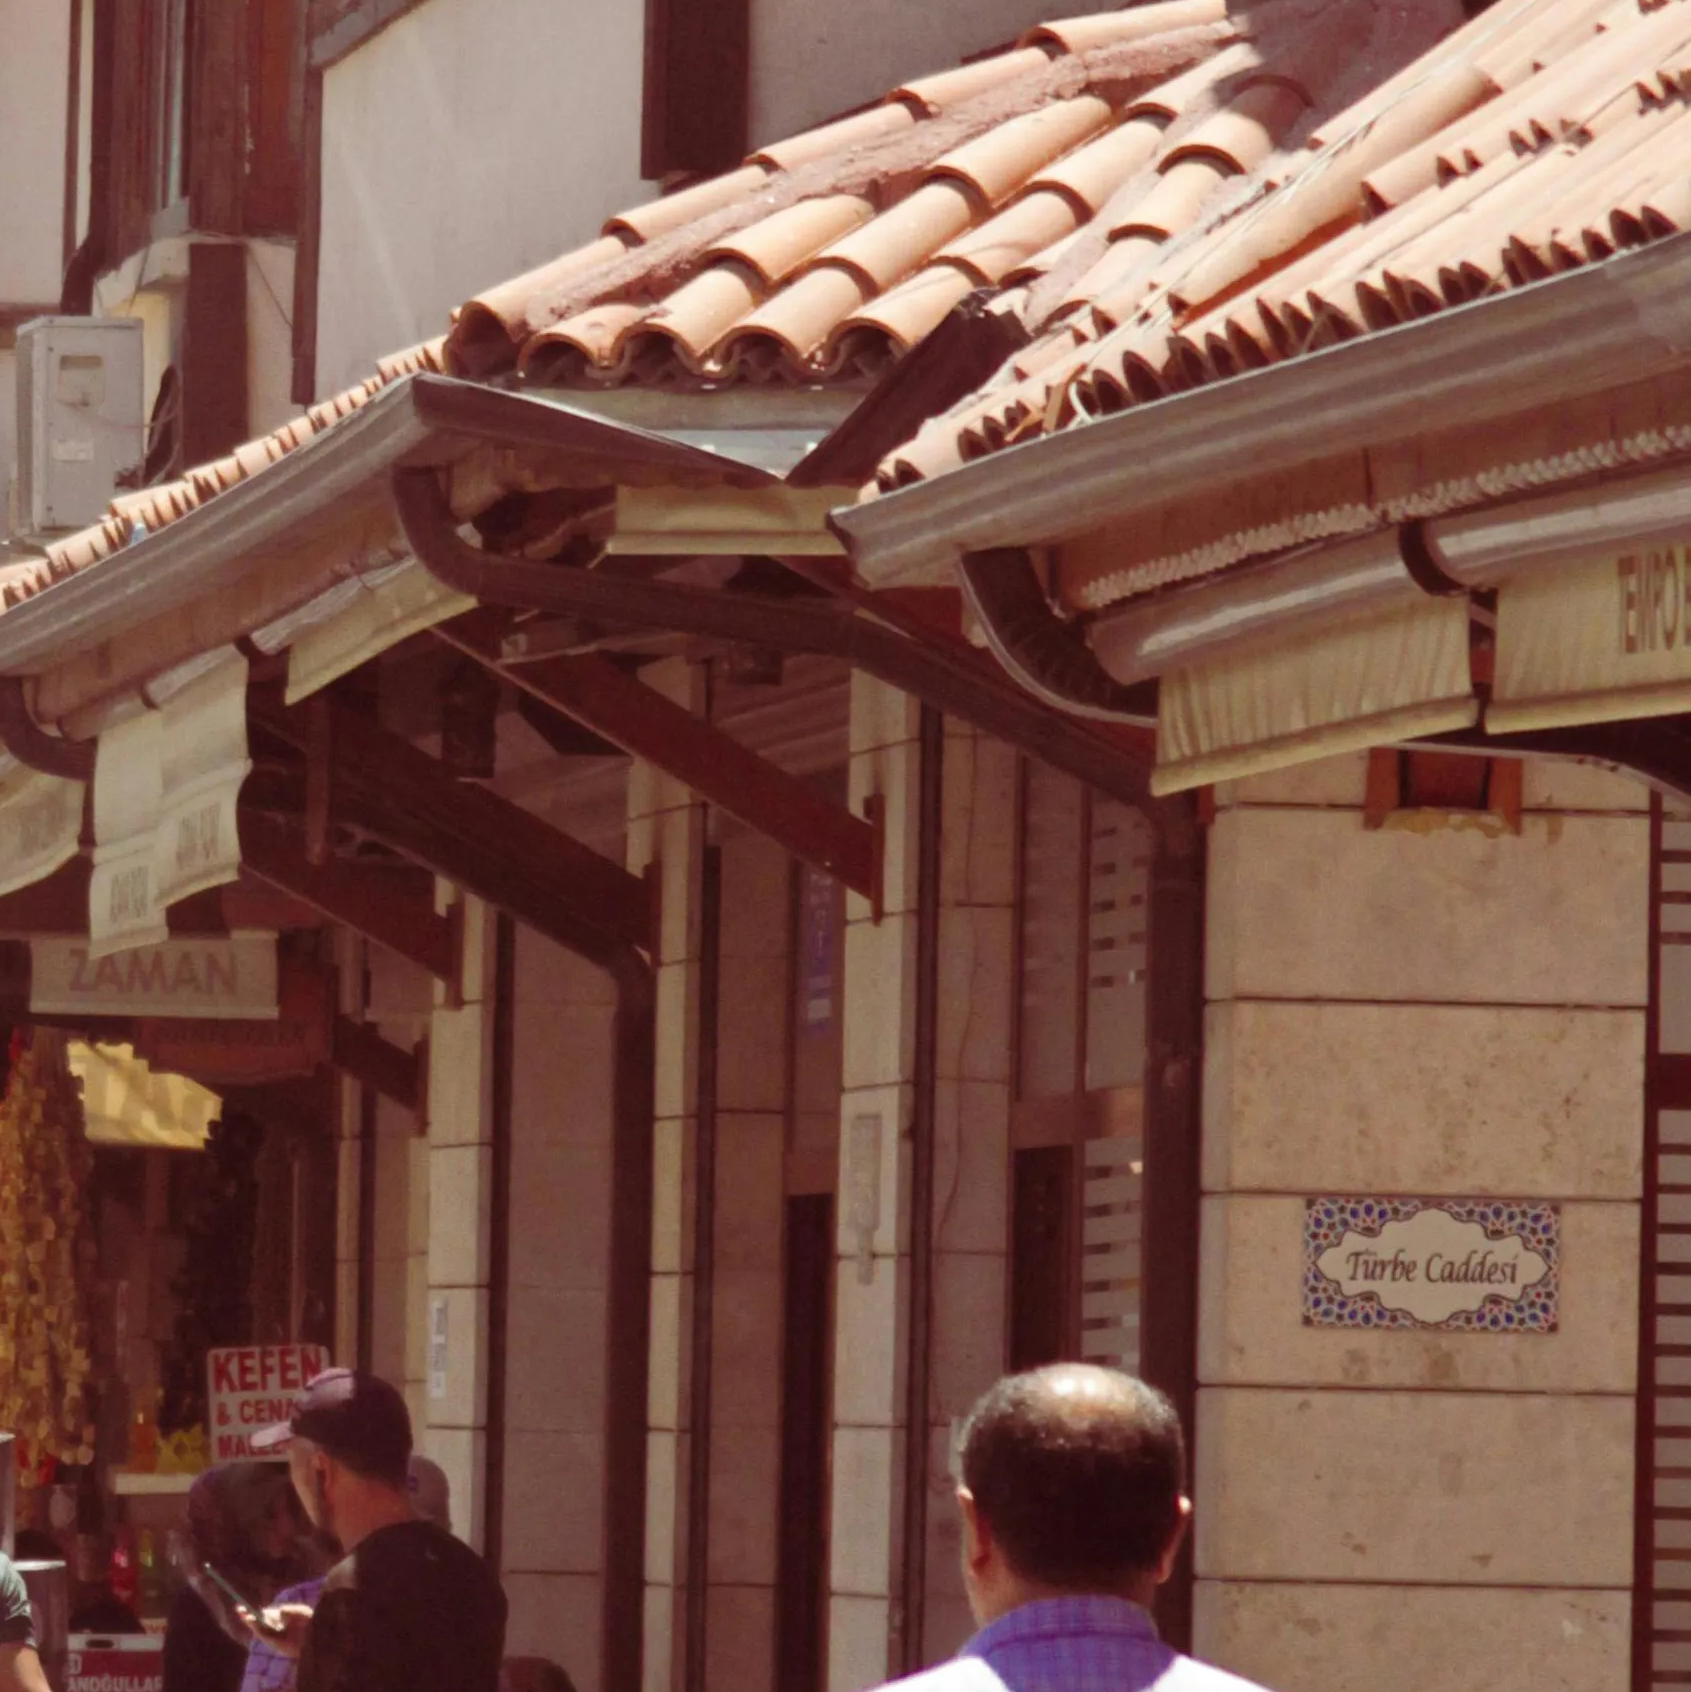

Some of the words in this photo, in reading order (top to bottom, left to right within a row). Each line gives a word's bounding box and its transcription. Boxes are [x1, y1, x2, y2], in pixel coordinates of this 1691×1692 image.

[68, 947, 239, 996] ZAMAN
[1345, 1248, 1418, 1283] Türbe
[1425, 1249, 1519, 1285] Caddesi
[212, 1348, 322, 1393] KEFEN
